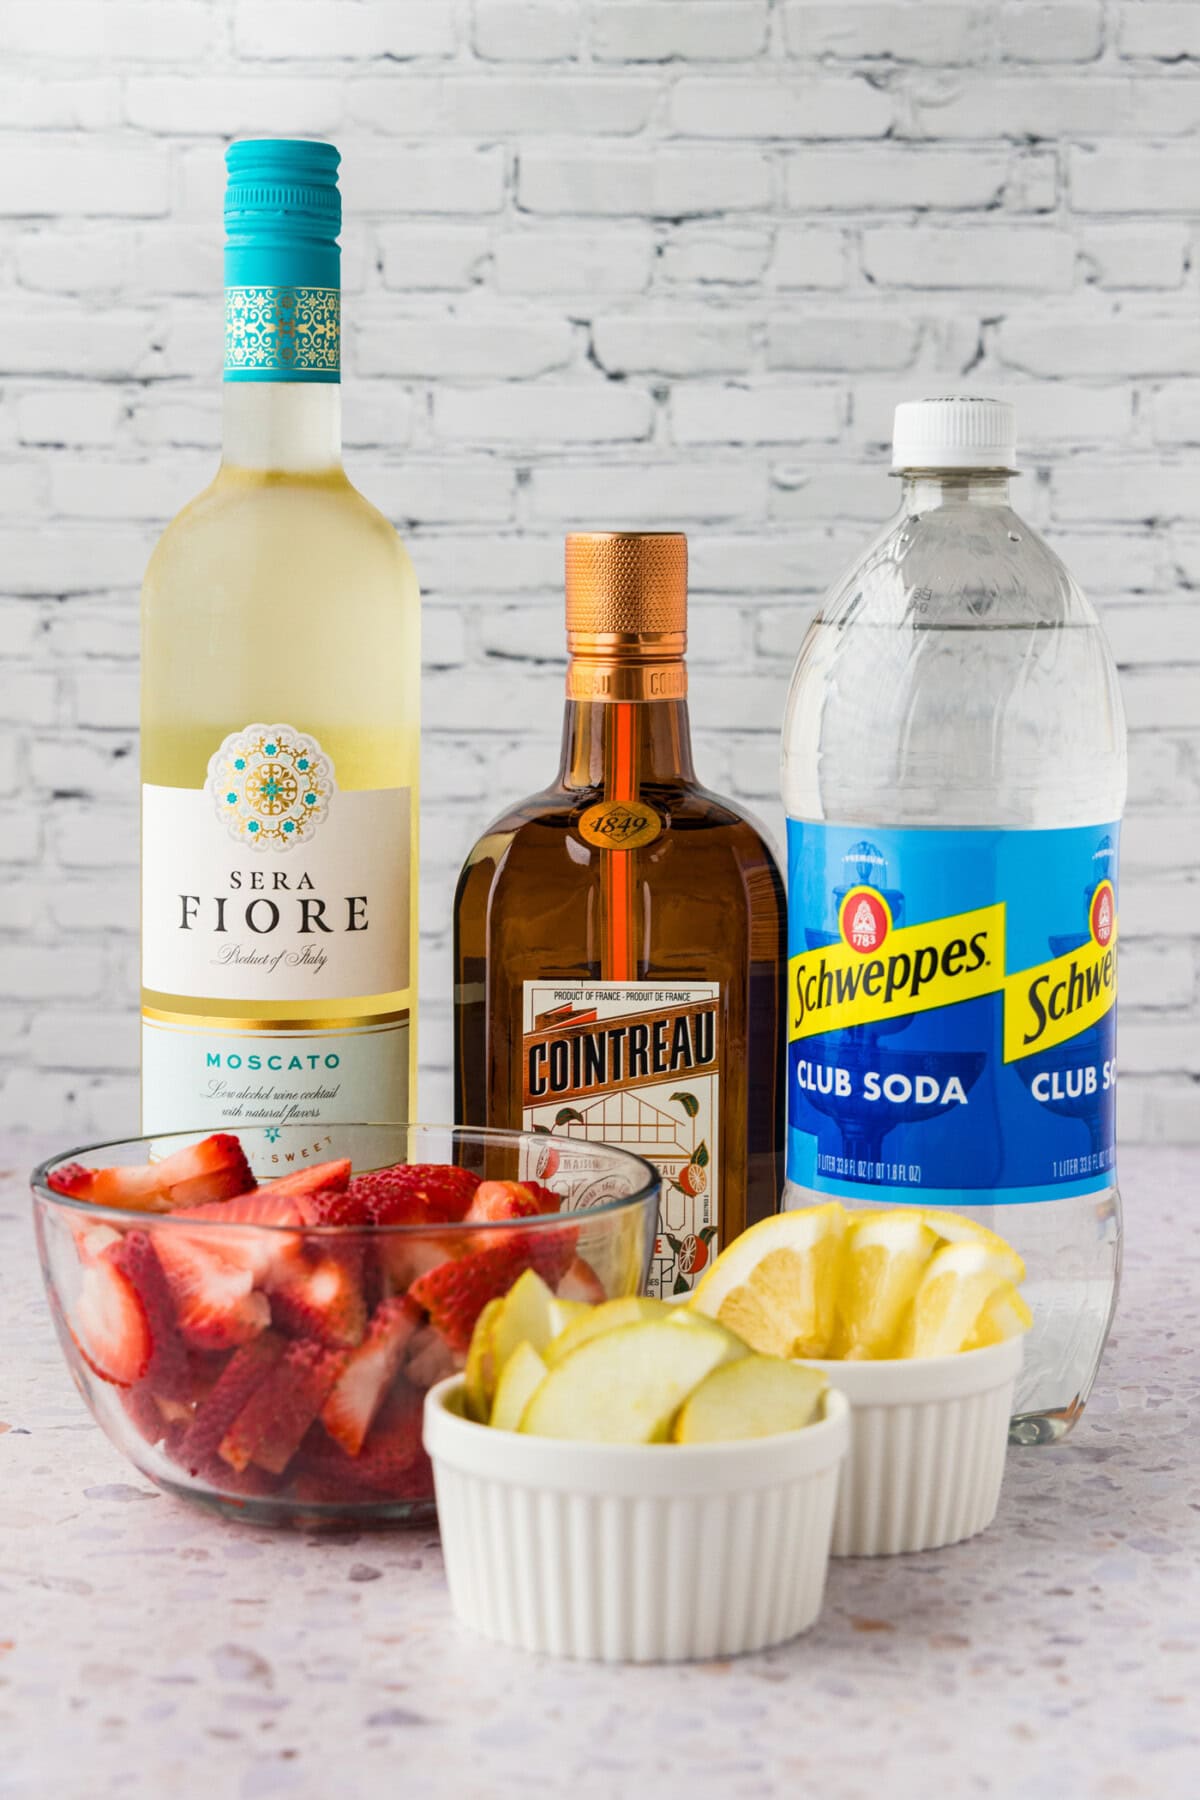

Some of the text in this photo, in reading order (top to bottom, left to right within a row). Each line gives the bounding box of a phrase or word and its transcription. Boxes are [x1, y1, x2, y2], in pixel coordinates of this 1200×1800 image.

[593, 816, 648, 832] 1849
[229, 870, 316, 890] SERA
[177, 894, 370, 934] FIORE
[852, 934, 877, 948] 1783
[211, 942, 329, 975] Product of Italy
[554, 991, 692, 1002] PRODUCT OF FRANCE PRODUIT DE FRANCE
[206, 1052, 340, 1071] MOSCATO
[528, 1010, 717, 1098] COINTREAU
[203, 1079, 341, 1100] Low alcohol wine cocktail
[797, 1060, 969, 1105] CLUB SODA
[1031, 1065, 1098, 1102] CLUB
[222, 1103, 321, 1125] with natural flavors
[270, 1135, 333, 1163] SWEET
[821, 1154, 836, 1172] LITER
[836, 1157, 849, 1174] 33.8
[849, 1159, 857, 1176] FL
[858, 1160, 867, 1178] OZ
[899, 1164, 907, 1181] FL
[1059, 1158, 1079, 1177] LITER
